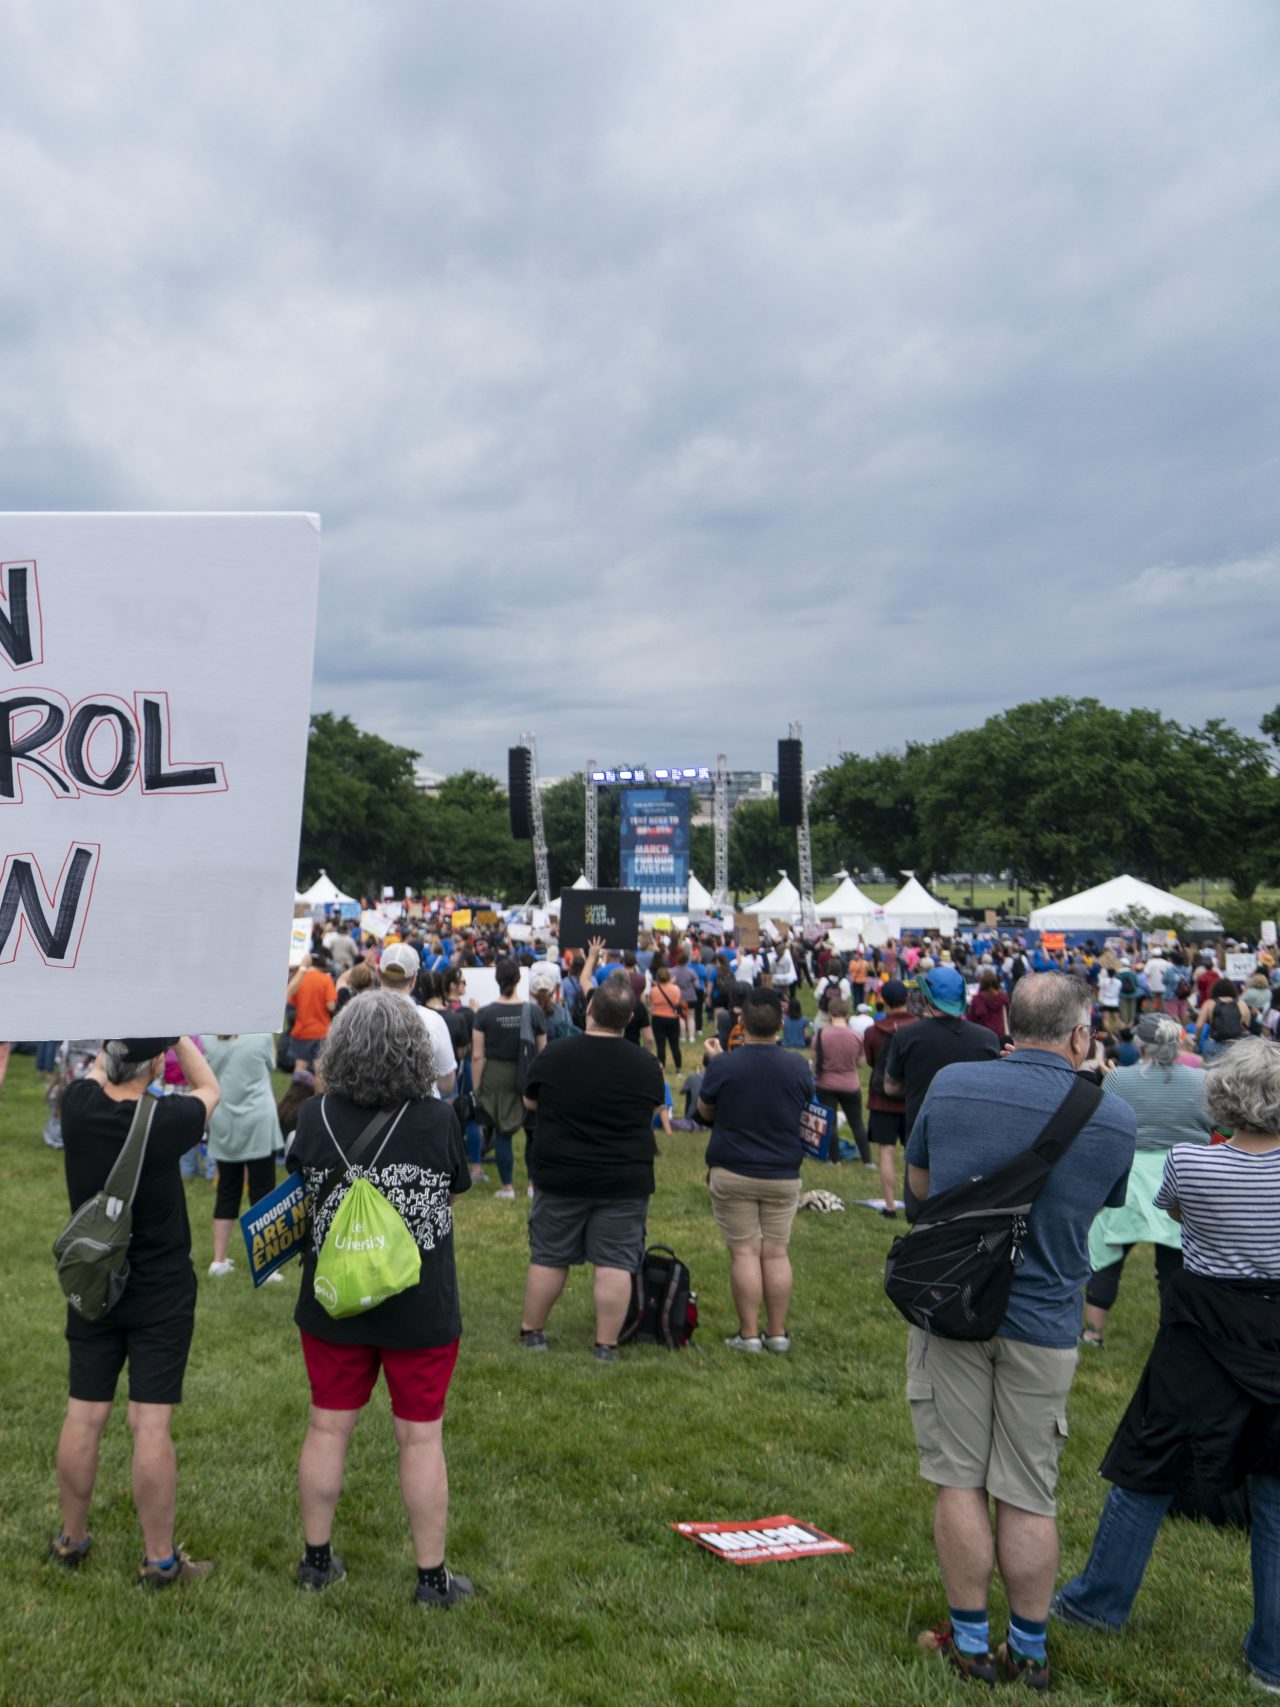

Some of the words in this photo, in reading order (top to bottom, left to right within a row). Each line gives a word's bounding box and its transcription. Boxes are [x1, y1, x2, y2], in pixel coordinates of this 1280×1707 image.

[634, 844, 669, 854] MARCH
[801, 1110, 828, 1136] EXT
[247, 1186, 304, 1235] THOUGHTS
[253, 1214, 288, 1254] ARE
[291, 1193, 313, 1224] NO
[253, 1222, 306, 1272] ENOU
